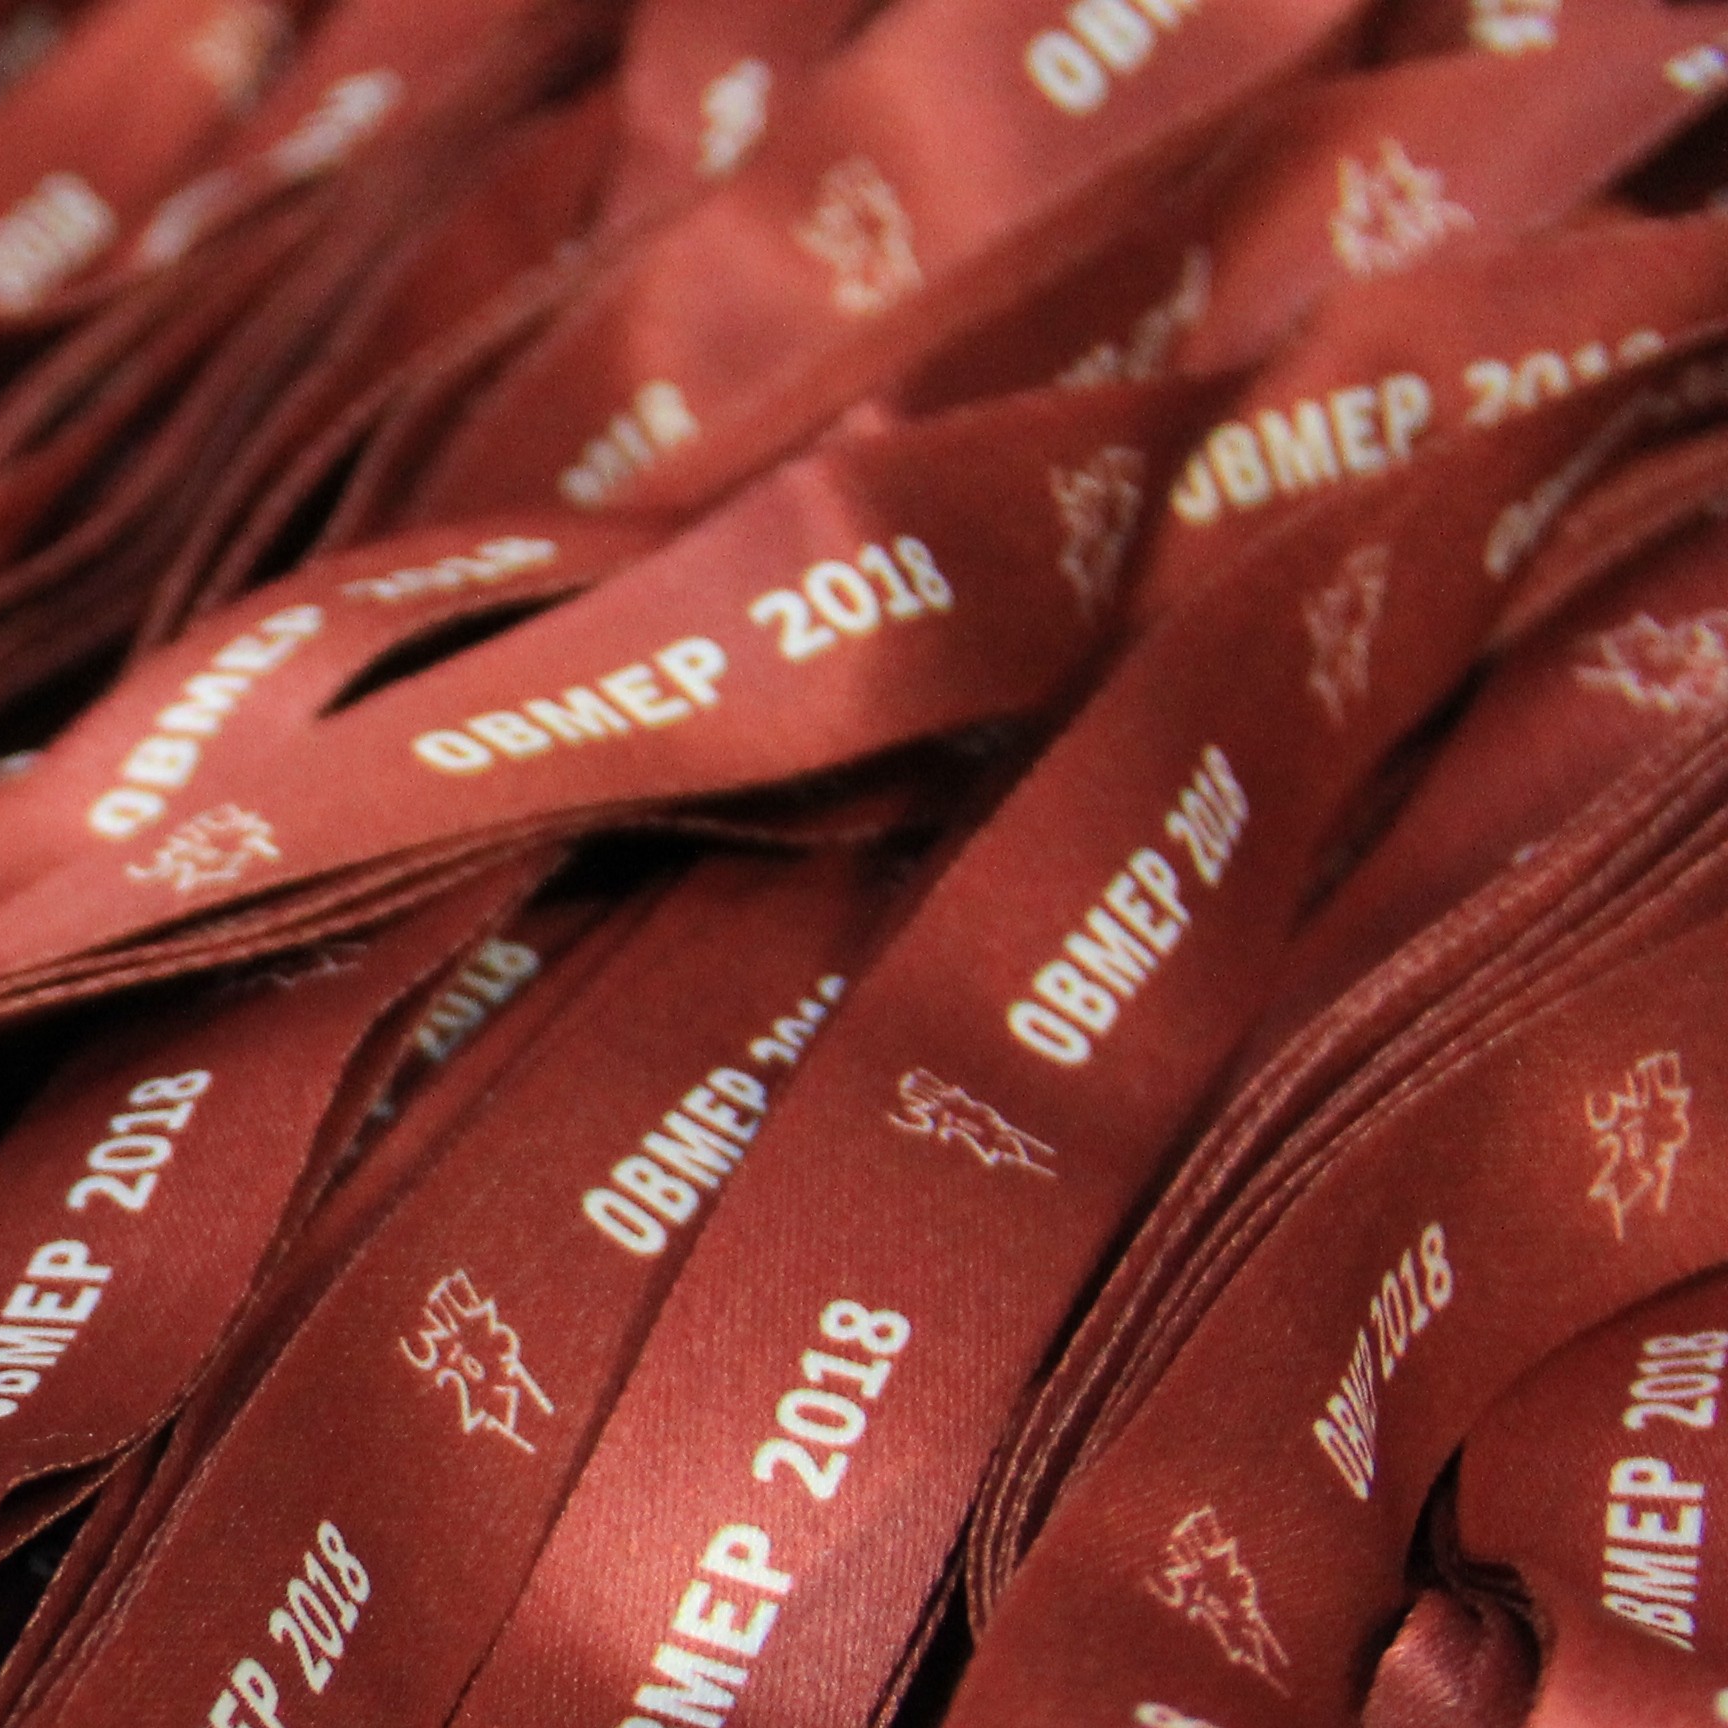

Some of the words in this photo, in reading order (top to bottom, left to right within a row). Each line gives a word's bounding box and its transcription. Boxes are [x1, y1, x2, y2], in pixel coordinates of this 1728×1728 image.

[88, 604, 325, 838] OBMEP
[412, 635, 729, 775] OBMEP
[751, 540, 956, 662] 2018
[1007, 846, 1190, 1067] OBMEP
[1164, 744, 1250, 887] 2018
[67, 1067, 212, 1212] 2018
[581, 1067, 768, 1255] OBMEP
[1370, 1221, 1454, 1381] 2018
[1622, 1329, 1728, 1432] 2018
[752, 1299, 912, 1500] 2018
[268, 1519, 373, 1695] 2018
